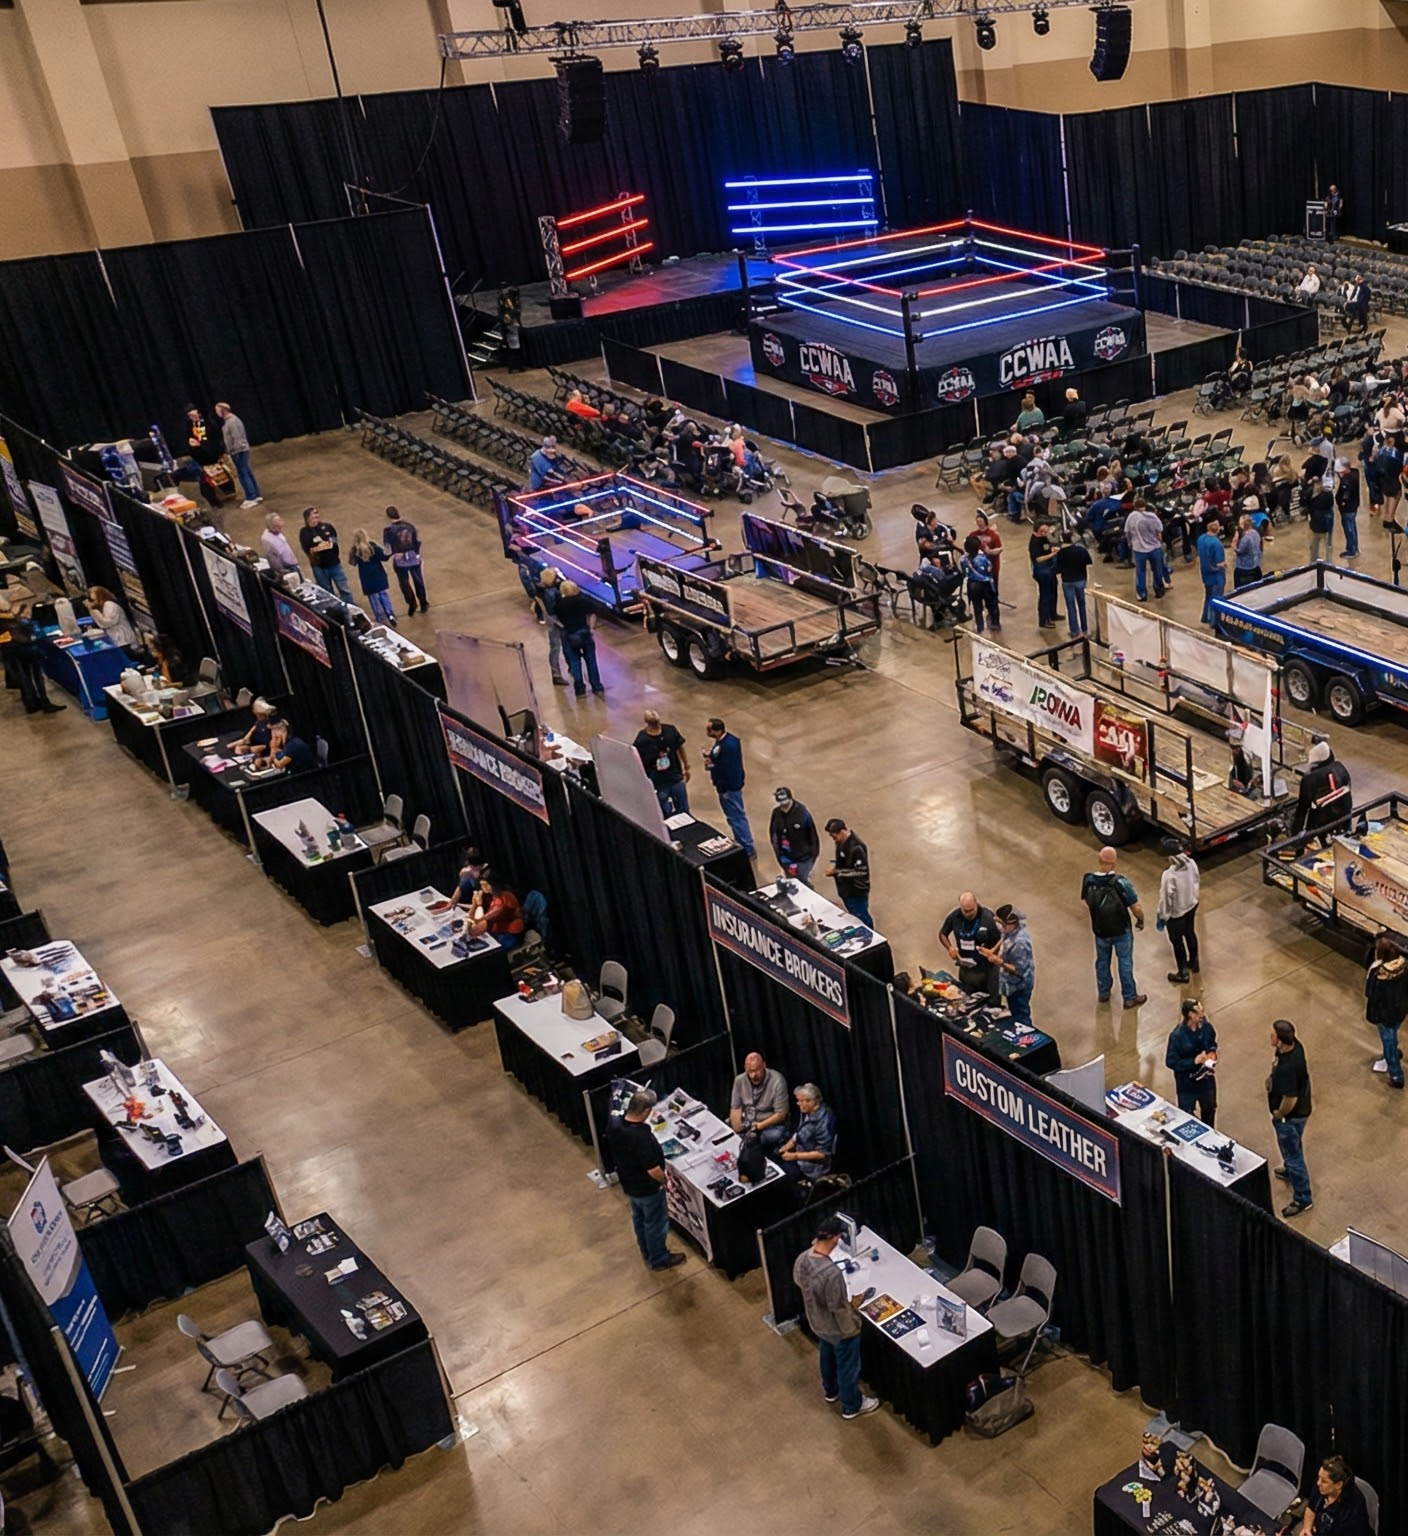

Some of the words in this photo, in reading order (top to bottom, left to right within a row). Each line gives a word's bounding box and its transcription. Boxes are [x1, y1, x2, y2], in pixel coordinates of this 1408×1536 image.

[800, 346, 855, 388] CCWAA
[1001, 340, 1075, 384] CCWAA
[712, 902, 784, 968] INSURANCE
[784, 949, 843, 1008] BROKERS
[955, 1058, 1025, 1126] CUSTOM
[1028, 1104, 1107, 1178] LEATHER
